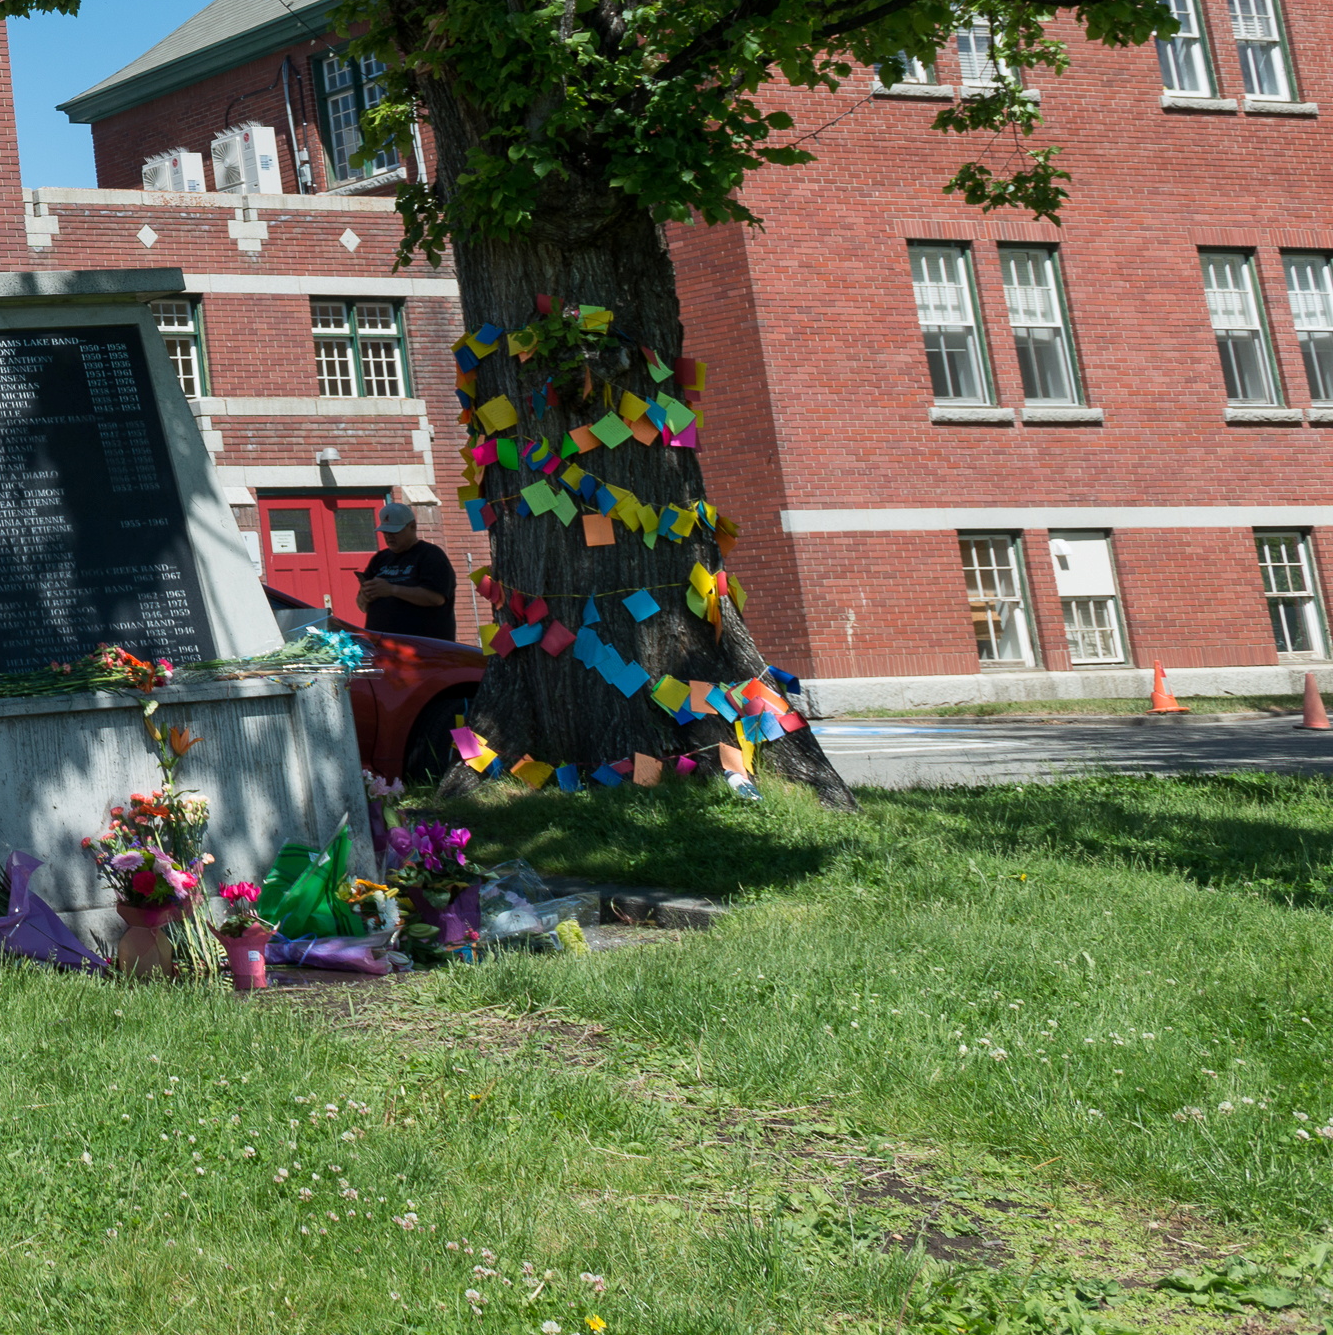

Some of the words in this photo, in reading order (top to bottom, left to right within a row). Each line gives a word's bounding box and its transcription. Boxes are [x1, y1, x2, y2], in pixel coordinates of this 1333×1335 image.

[22, 338, 49, 346] LAKE
[7, 355, 54, 364] ANTHONY
[0, 364, 44, 373] BENNETT
[82, 361, 103, 369] 1930
[110, 360, 131, 368] 1936
[84, 370, 105, 378] 1951
[0, 391, 39, 400] MICHEL
[21, 471, 59, 479] DIABLO
[0, 481, 25, 489] DICK
[23, 488, 66, 497] DUMONT
[20, 497, 62, 507] ETIENNE
[23, 516, 66, 525] ETIENNE
[30, 524, 73, 534] ETIENNE
[119, 519, 141, 527] 1955
[147, 518, 169, 526] 1961
[132, 573, 154, 581] 1963
[161, 571, 182, 580] 1967
[136, 591, 158, 600] 1962
[165, 590, 186, 598] 1963
[138, 601, 160, 609] 1973
[167, 599, 188, 608] 1974
[140, 610, 162, 619] 1946
[169, 608, 190, 617] 1959
[108, 621, 144, 630] INDIAN
[145, 628, 167, 637] 1938
[173, 626, 195, 635] 1946
[149, 647, 171, 655] 1963
[178, 645, 199, 653] 1964
